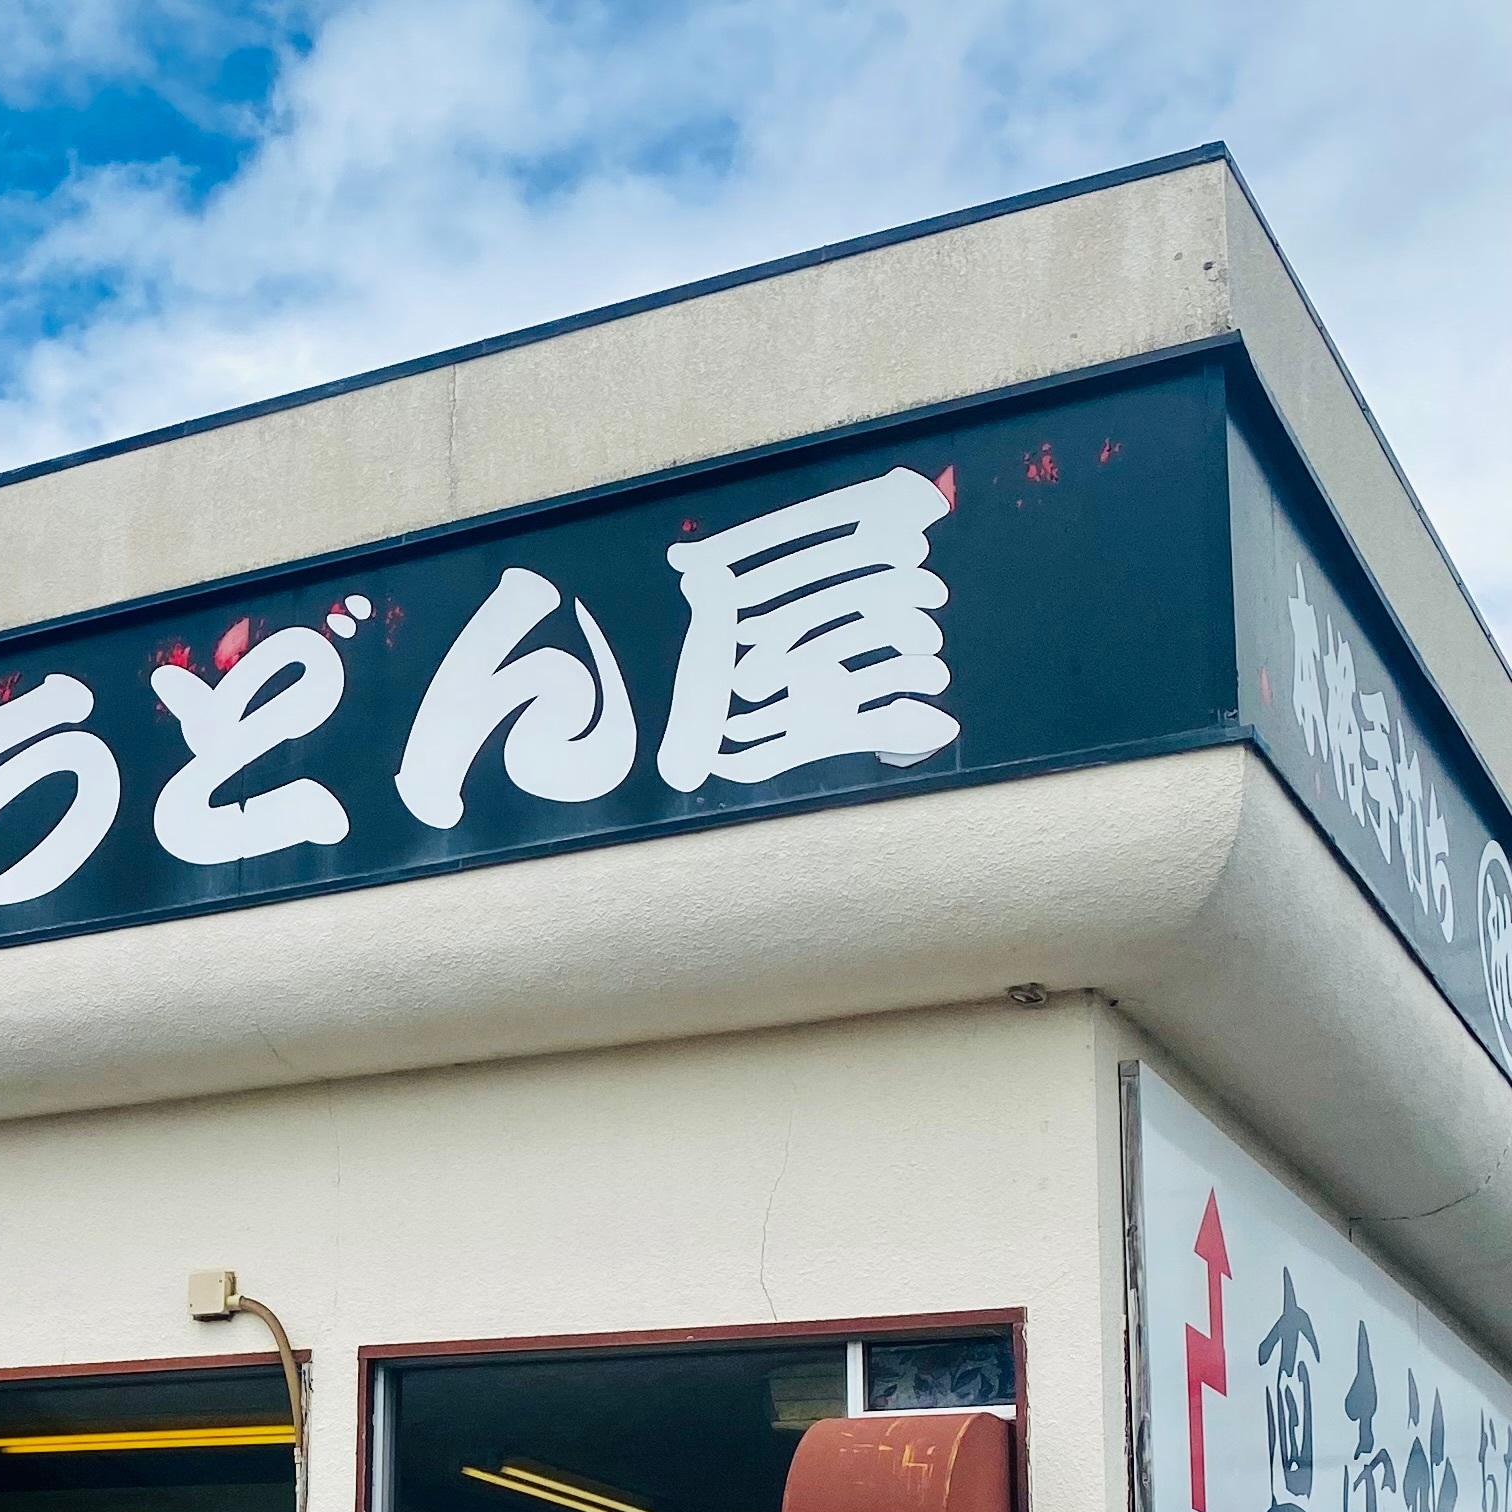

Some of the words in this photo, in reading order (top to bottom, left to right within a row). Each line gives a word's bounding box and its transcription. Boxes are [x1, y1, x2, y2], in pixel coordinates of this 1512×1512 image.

[1288, 561, 1455, 944] 本格手打ち
